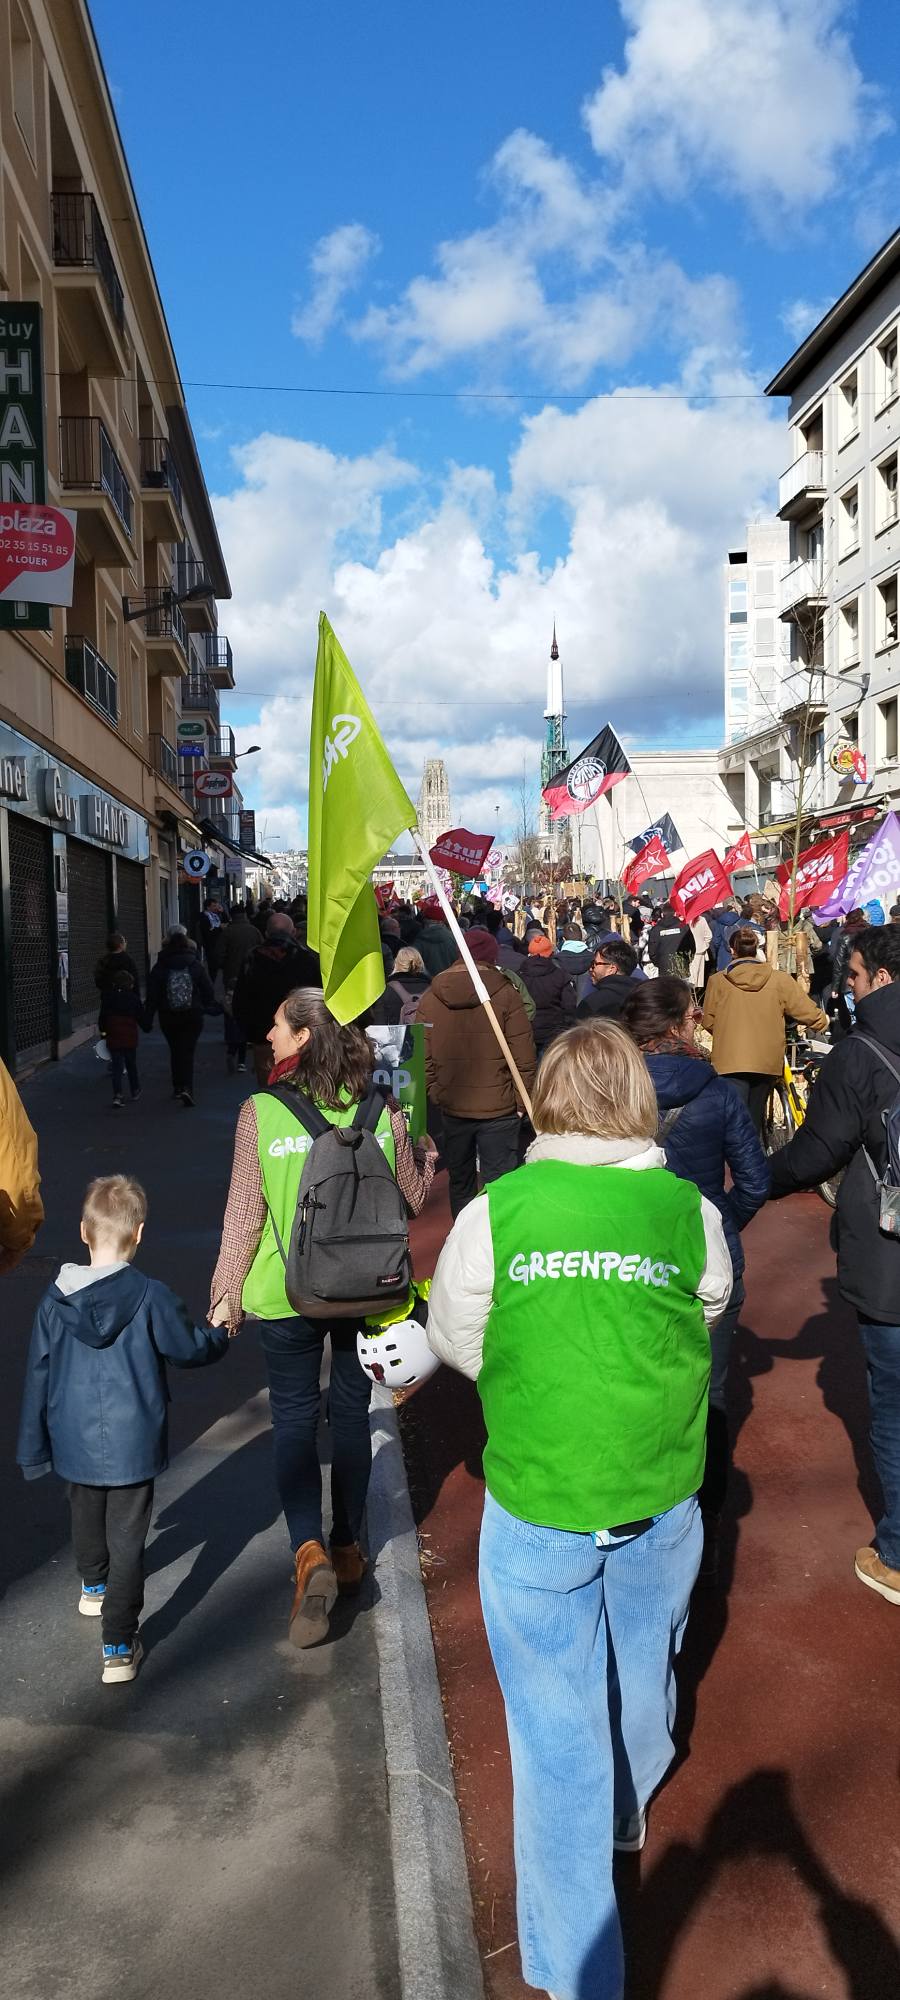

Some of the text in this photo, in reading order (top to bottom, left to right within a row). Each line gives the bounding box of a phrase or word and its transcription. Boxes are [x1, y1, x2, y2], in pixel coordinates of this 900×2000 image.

[7, 555, 48, 566] A LOUER
[13, 541, 26, 550] 35
[28, 543, 40, 552] 15
[42, 544, 54, 554] 51
[56, 546, 69, 556] 85
[0, 758, 29, 801] net
[508, 1251, 680, 1287] GREENPEACE
